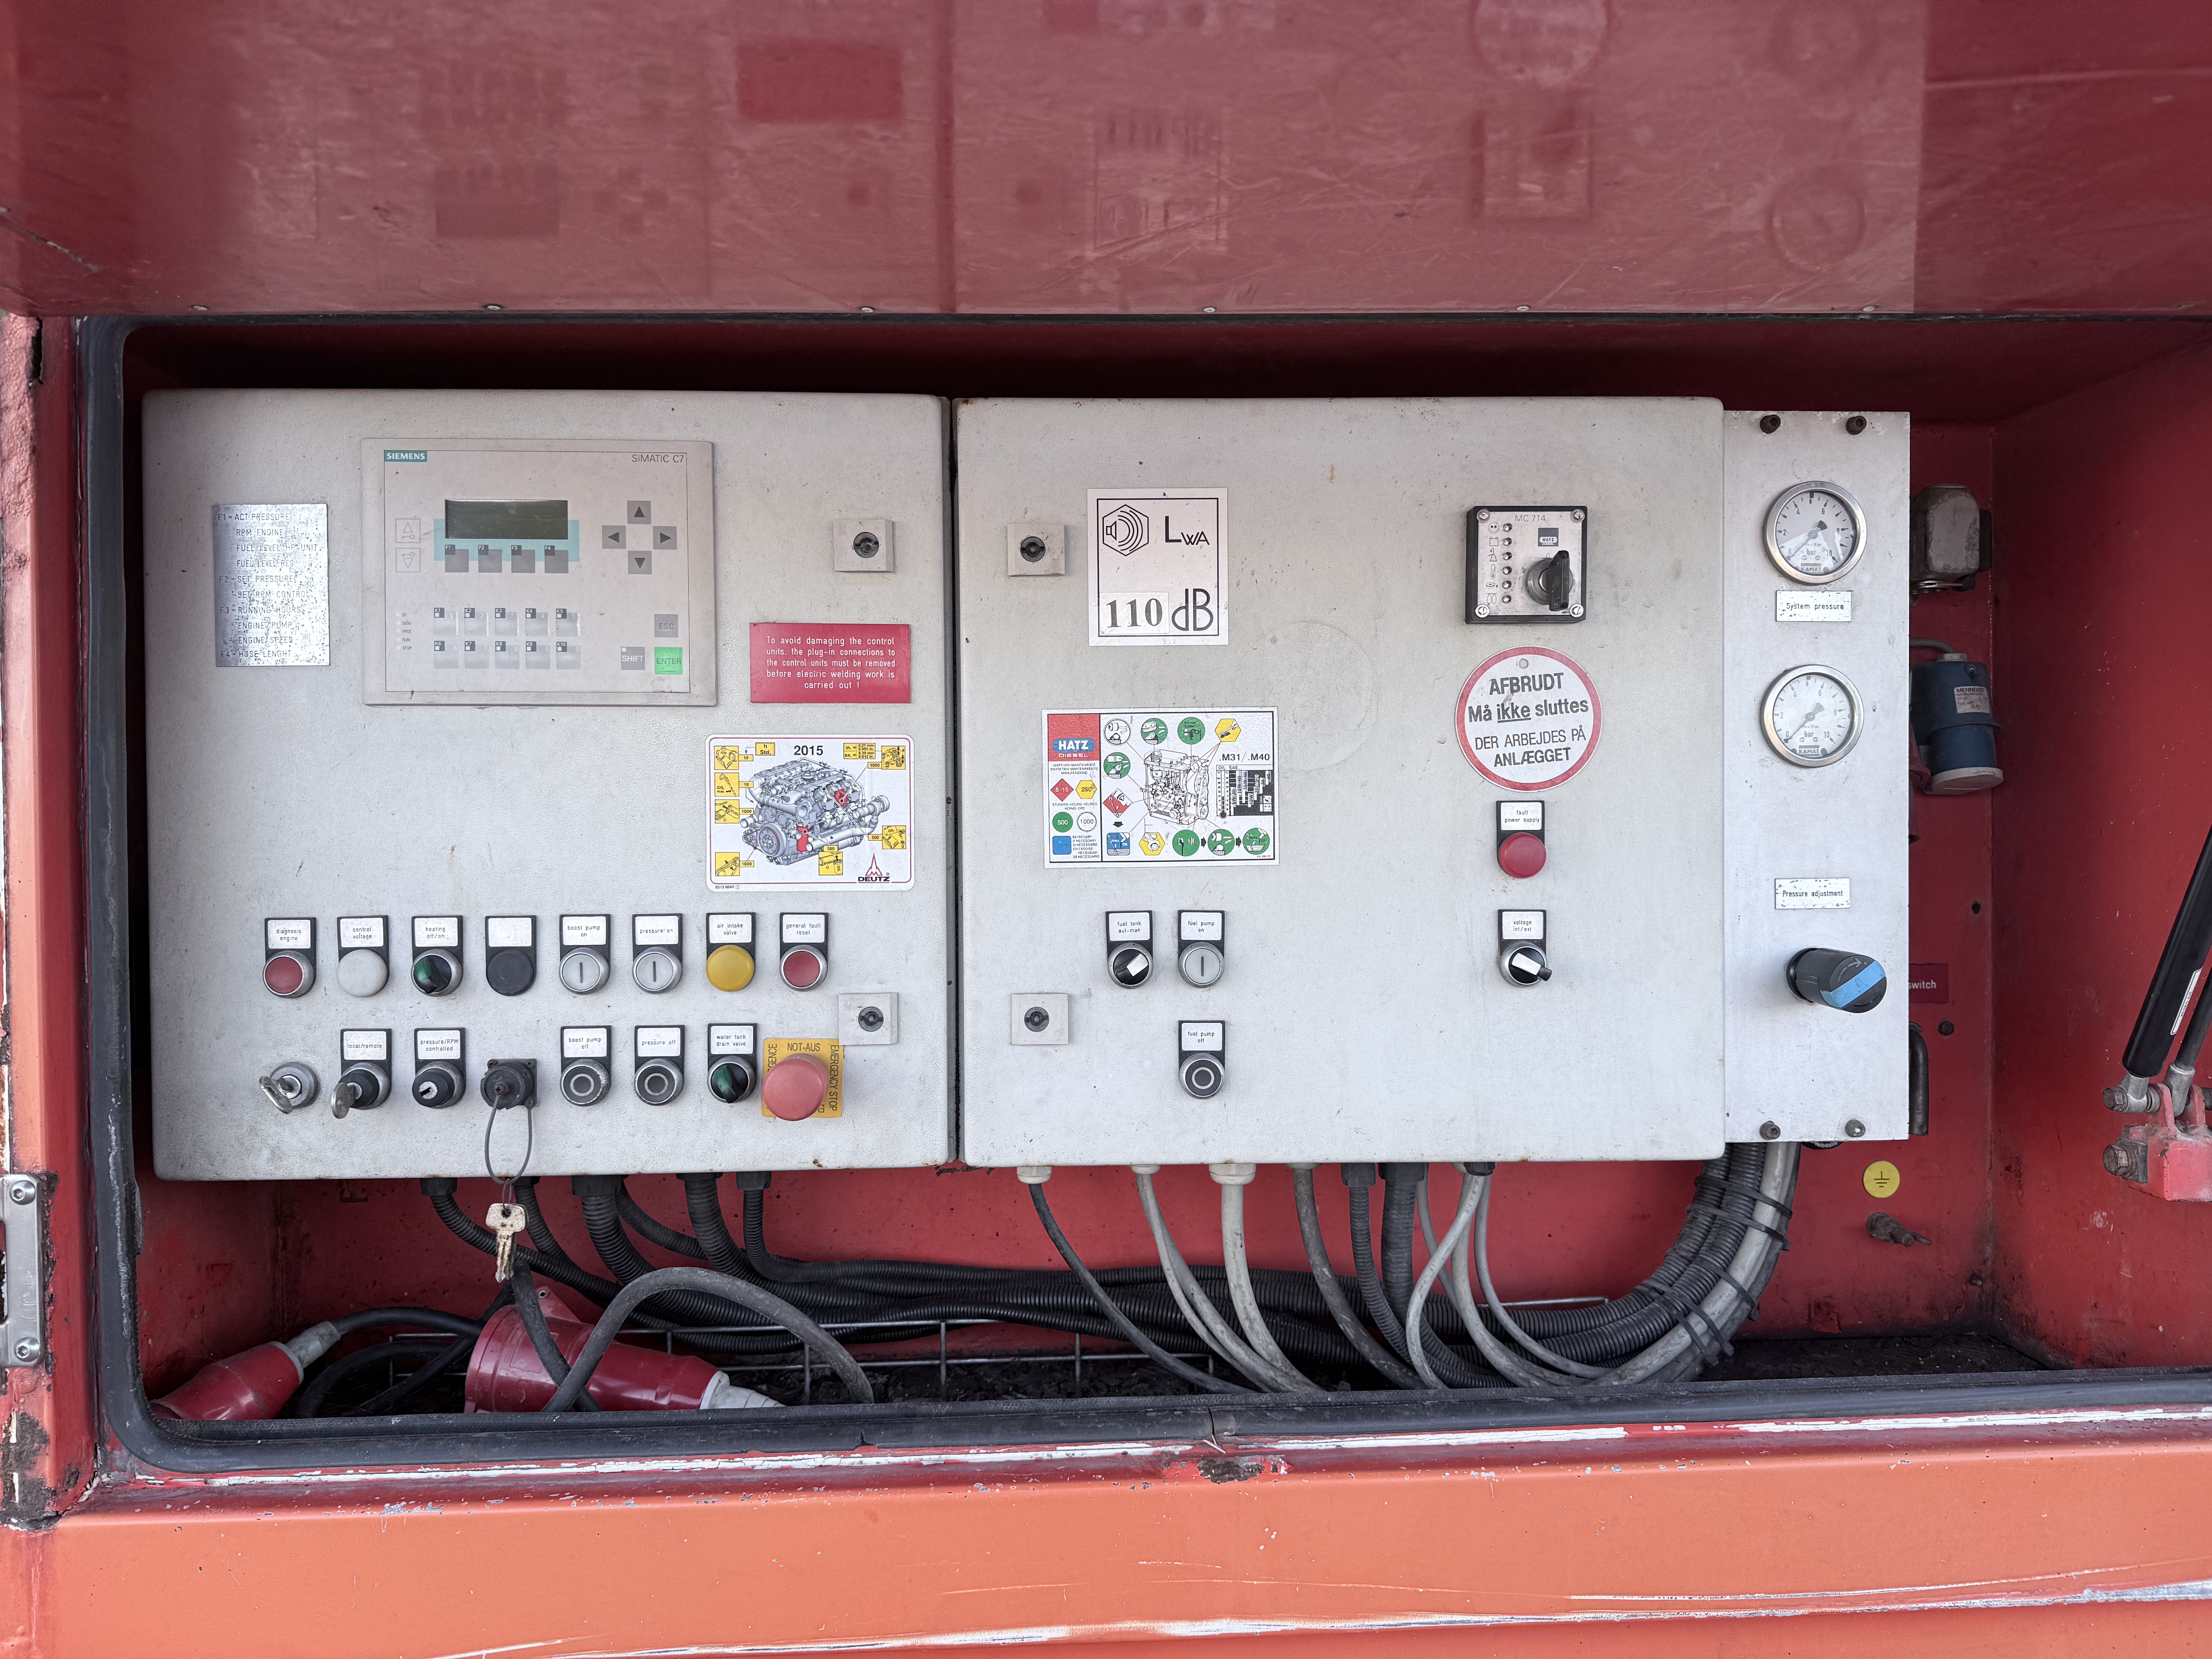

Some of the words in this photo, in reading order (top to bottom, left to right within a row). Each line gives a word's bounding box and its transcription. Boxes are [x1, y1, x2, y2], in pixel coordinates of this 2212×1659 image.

[632, 454, 669, 462] SIMATIC
[1106, 598, 1163, 628] 110
[1171, 588, 1214, 631] dB
[766, 636, 775, 644] To
[807, 637, 845, 646] damaging
[867, 637, 894, 645] control
[808, 649, 835, 657] plug-in
[831, 671, 860, 679] welding
[1489, 673, 1564, 695] AFBRUDT
[1468, 704, 1492, 722] Må
[1497, 703, 1531, 720] ikke
[1535, 699, 1589, 716] sluttes
[1475, 736, 1499, 750] DER
[1504, 730, 1566, 747] ARBEJDES
[1571, 725, 1586, 741] PÅ
[1058, 740, 1089, 750] HATZ
[793, 745, 823, 756] 2015
[1494, 747, 1571, 767] ANLÆGGET
[1811, 890, 1843, 898] adjustment
[1909, 980, 1936, 989] switch
[787, 1043, 820, 1051] NOT-AUS
[830, 1045, 839, 1089] EMERGENCY
[829, 1092, 838, 1111] STOP
